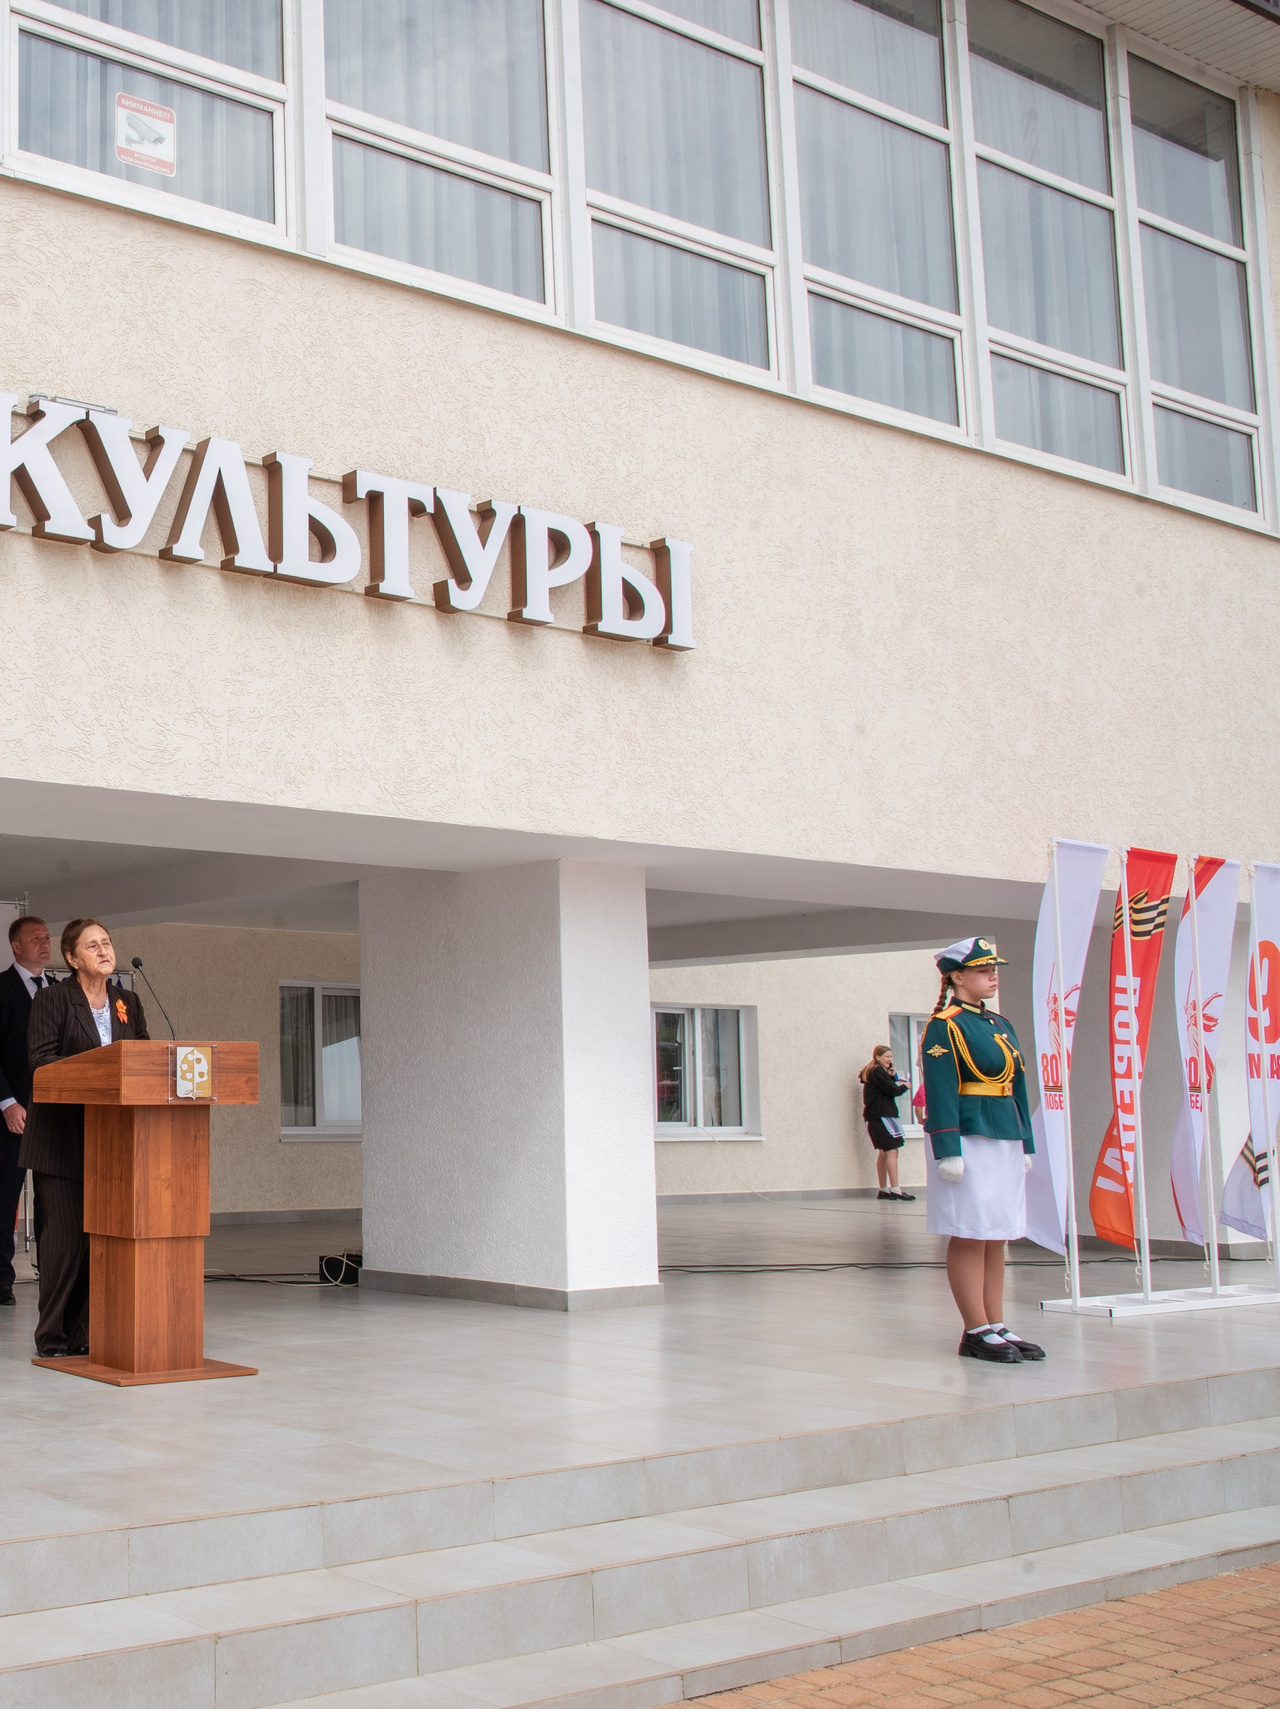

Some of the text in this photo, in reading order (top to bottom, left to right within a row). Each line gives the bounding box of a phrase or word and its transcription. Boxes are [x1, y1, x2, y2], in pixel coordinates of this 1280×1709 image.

[121, 98, 170, 120] ВНИМАНИЕ!!!
[1248, 940, 1280, 1044] 9
[1041, 1053, 1060, 1087] 80
